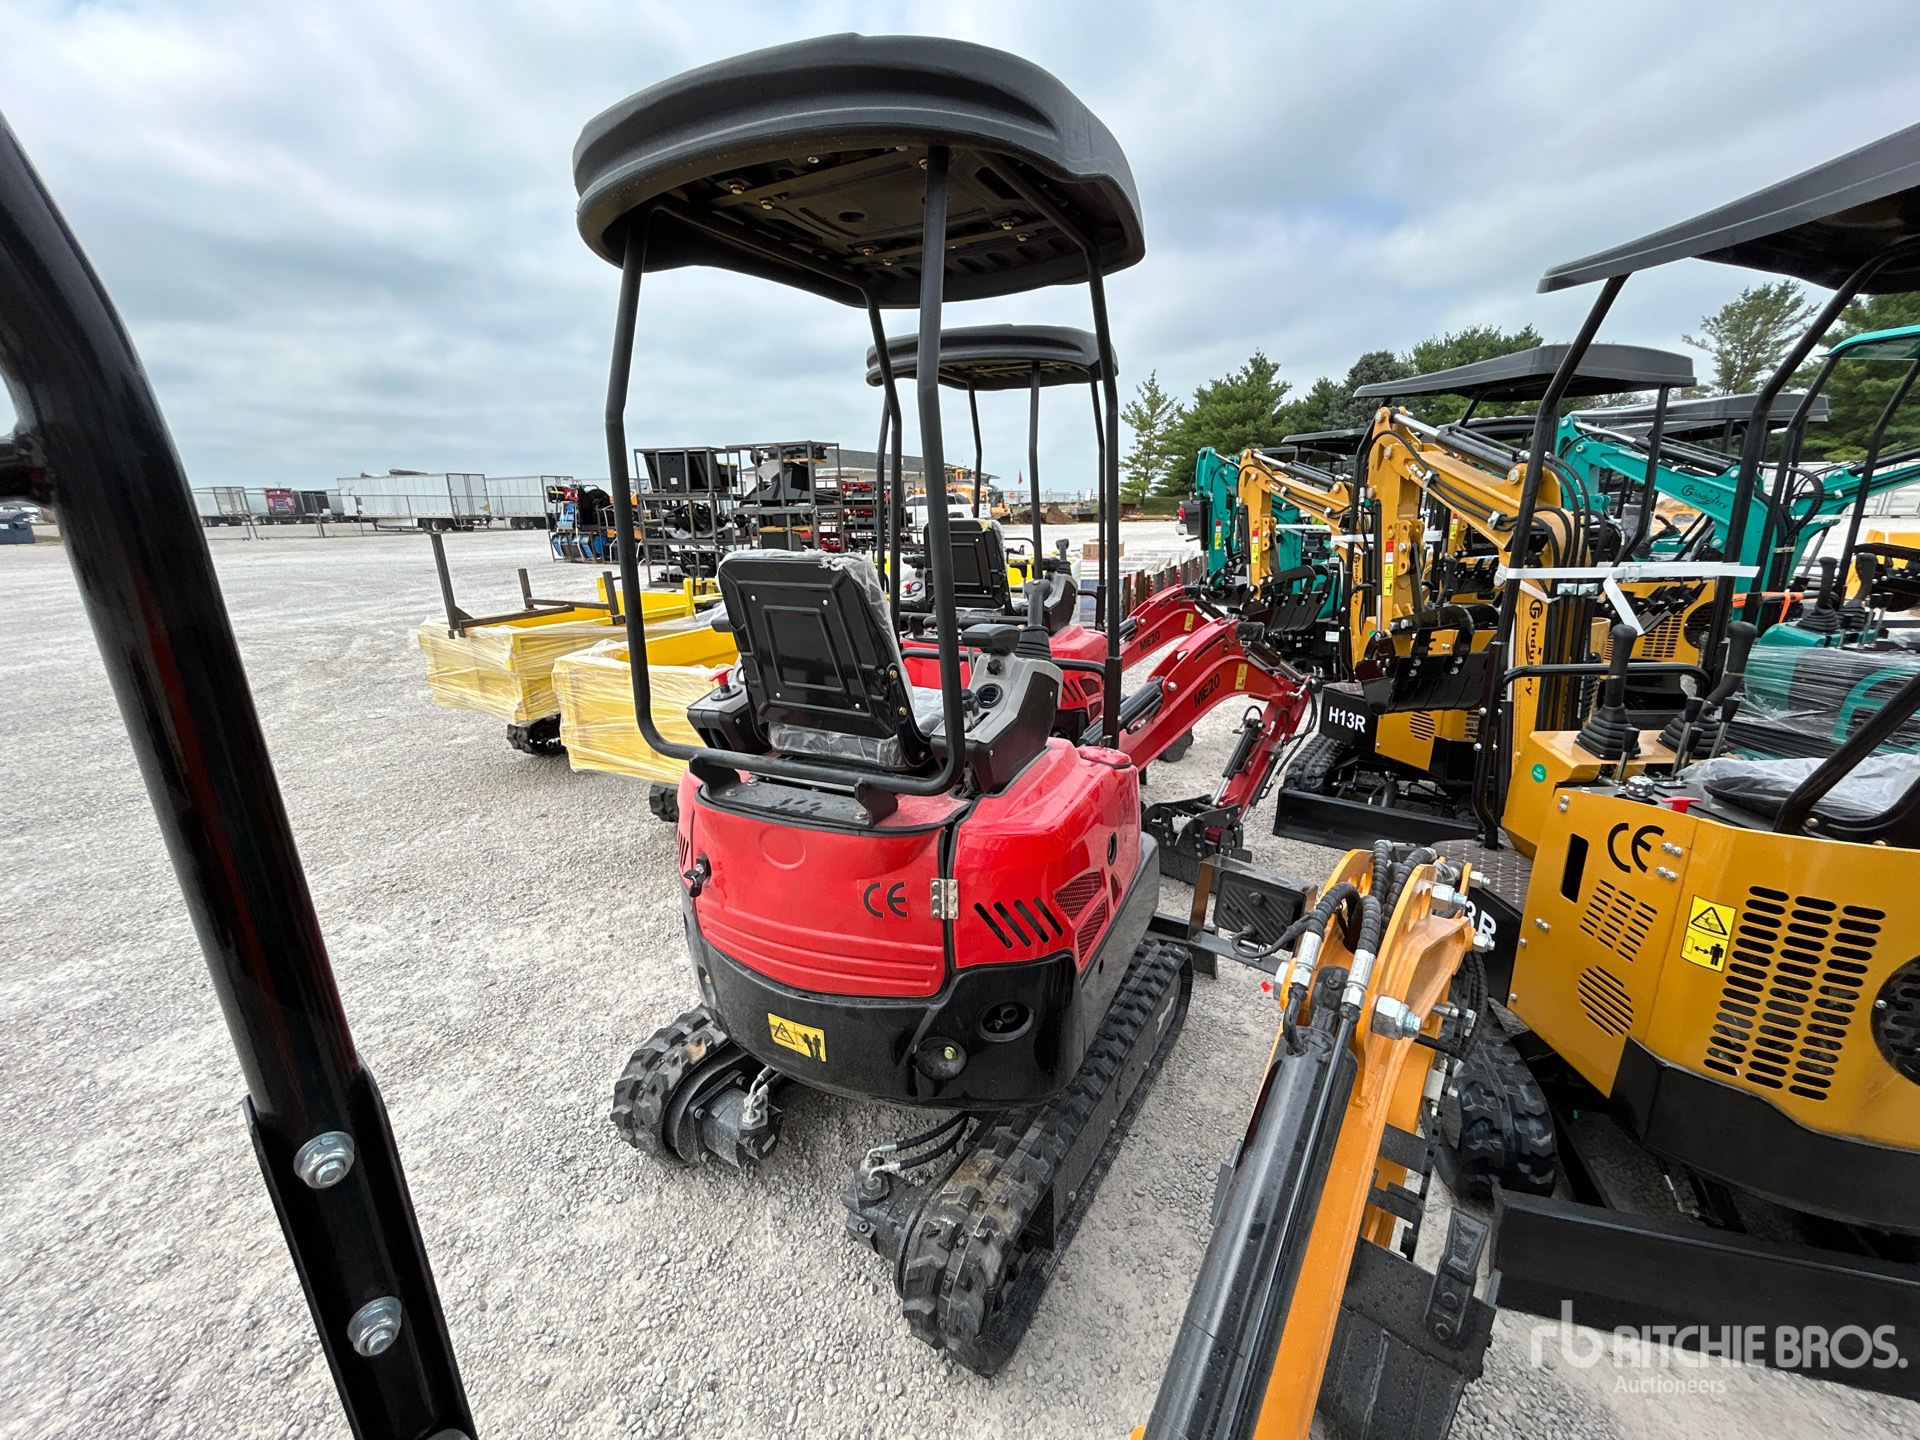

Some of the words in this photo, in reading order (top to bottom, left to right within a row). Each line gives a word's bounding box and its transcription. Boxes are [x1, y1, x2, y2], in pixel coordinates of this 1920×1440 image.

[1140, 630, 1160, 651] ME20
[1194, 673, 1219, 707] ME20
[1328, 706, 1366, 733] H13R
[1608, 822, 1664, 874] CE
[863, 882, 908, 918] CE
